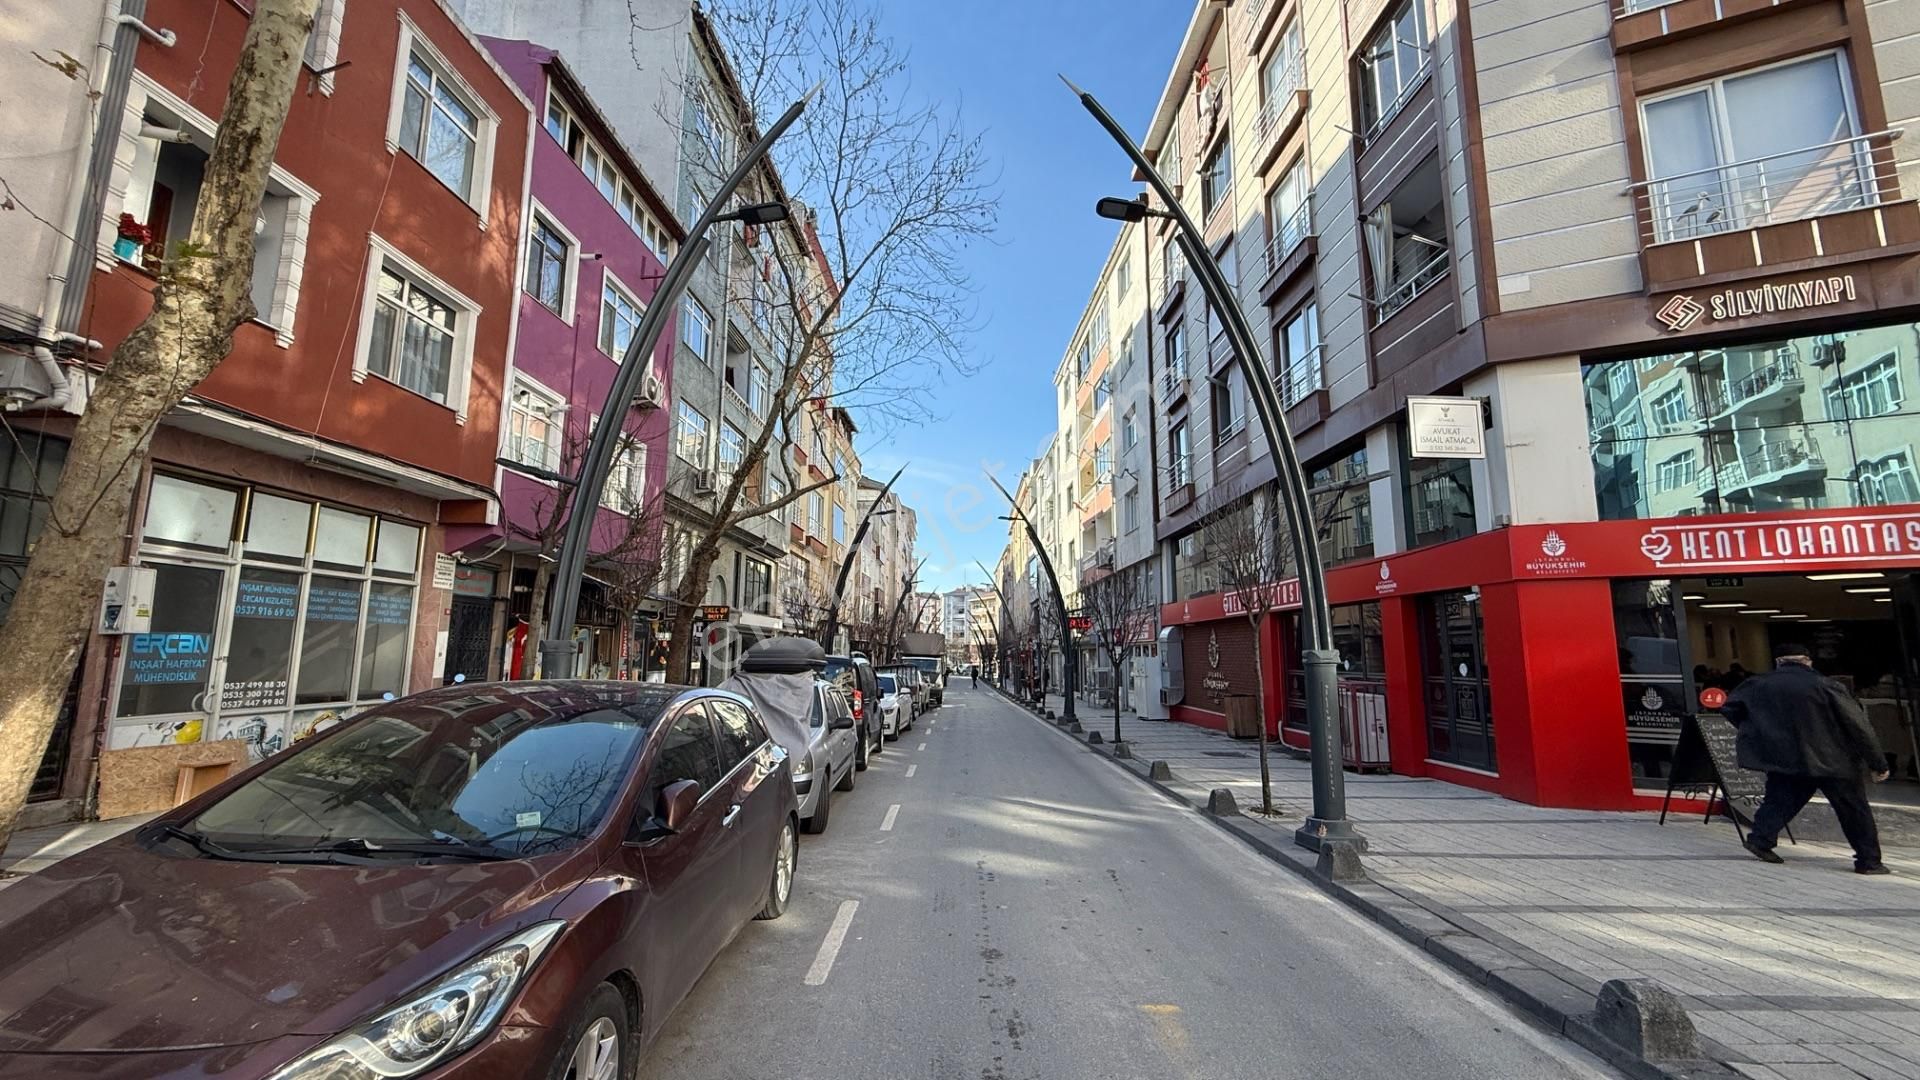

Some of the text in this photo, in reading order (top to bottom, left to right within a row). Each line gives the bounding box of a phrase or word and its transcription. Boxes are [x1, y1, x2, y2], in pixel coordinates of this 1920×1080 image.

[1710, 275, 1855, 320] SİLVİYAYAPI
[1432, 427, 1460, 435] AVUKAT
[1444, 436, 1475, 445] ATMACA
[1680, 529, 1747, 560] KENT
[235, 604, 295, 617] 0537 916 69 00
[224, 682, 244, 690] 0537
[247, 681, 262, 689] 499
[223, 691, 244, 699] 0535
[246, 690, 261, 698] 300
[221, 700, 241, 709] 0537
[244, 699, 260, 707] 447
